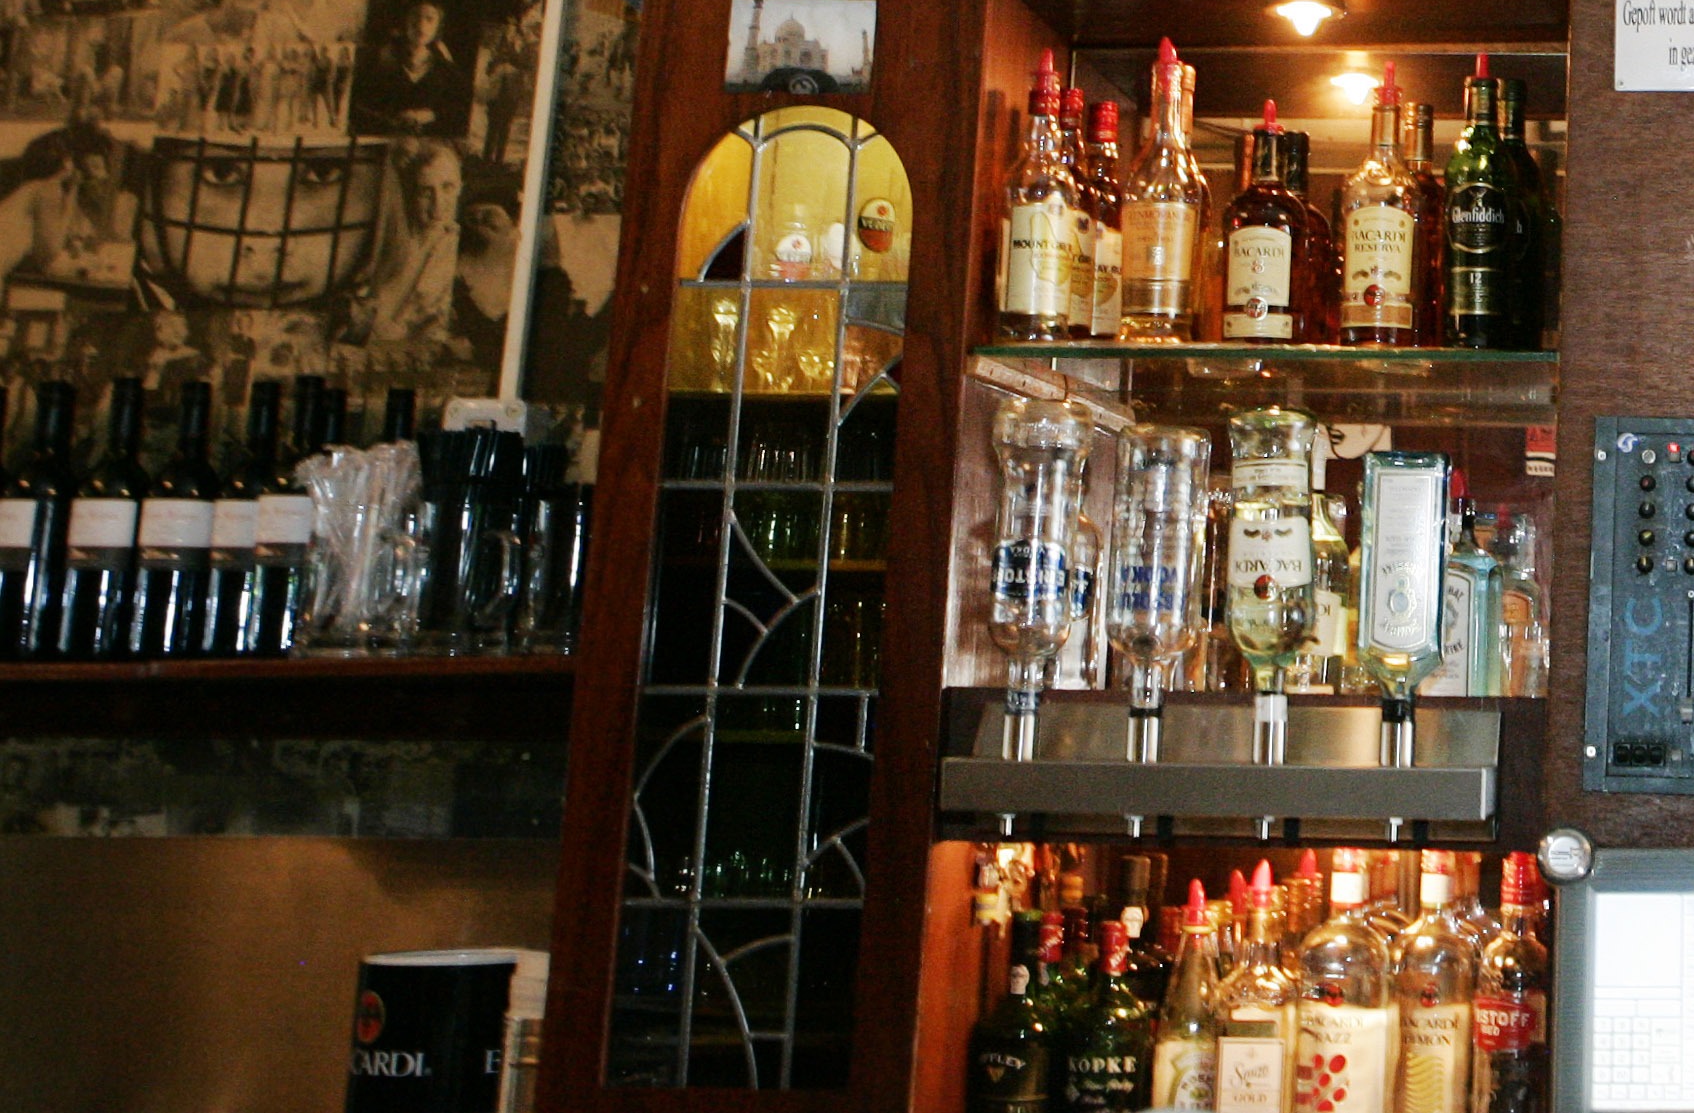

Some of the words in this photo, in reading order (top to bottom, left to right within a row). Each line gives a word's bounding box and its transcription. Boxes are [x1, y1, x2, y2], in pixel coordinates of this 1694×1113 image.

[1623, 0, 1657, 32] Gepoft
[1658, 0, 1688, 26] wordt
[1668, 38, 1678, 66] in
[1452, 206, 1505, 224] Glenfiddich
[1351, 229, 1407, 243] BACARDI
[1233, 246, 1285, 258] BACARDI
[1353, 243, 1402, 254] RESERVA
[1470, 272, 1482, 284] 12
[1234, 559, 1302, 574] BACARDI
[1622, 596, 1664, 718] XTC
[1067, 1054, 1139, 1074] KOPKE
